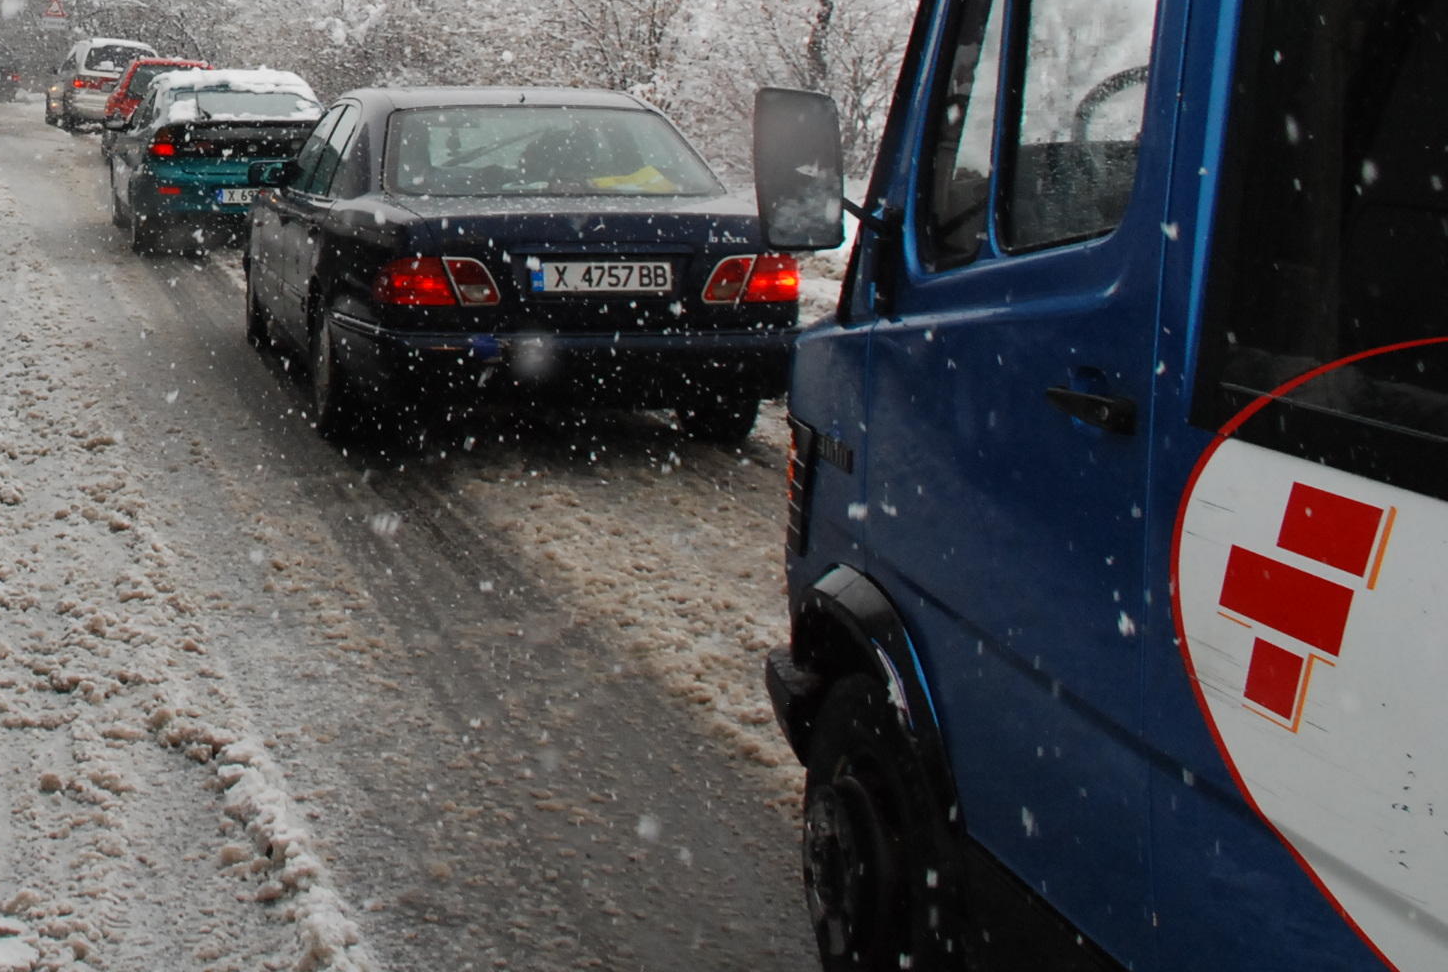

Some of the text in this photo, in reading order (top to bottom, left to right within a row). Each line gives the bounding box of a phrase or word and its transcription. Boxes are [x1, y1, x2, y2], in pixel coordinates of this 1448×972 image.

[554, 265, 668, 289] X 4757 BB
